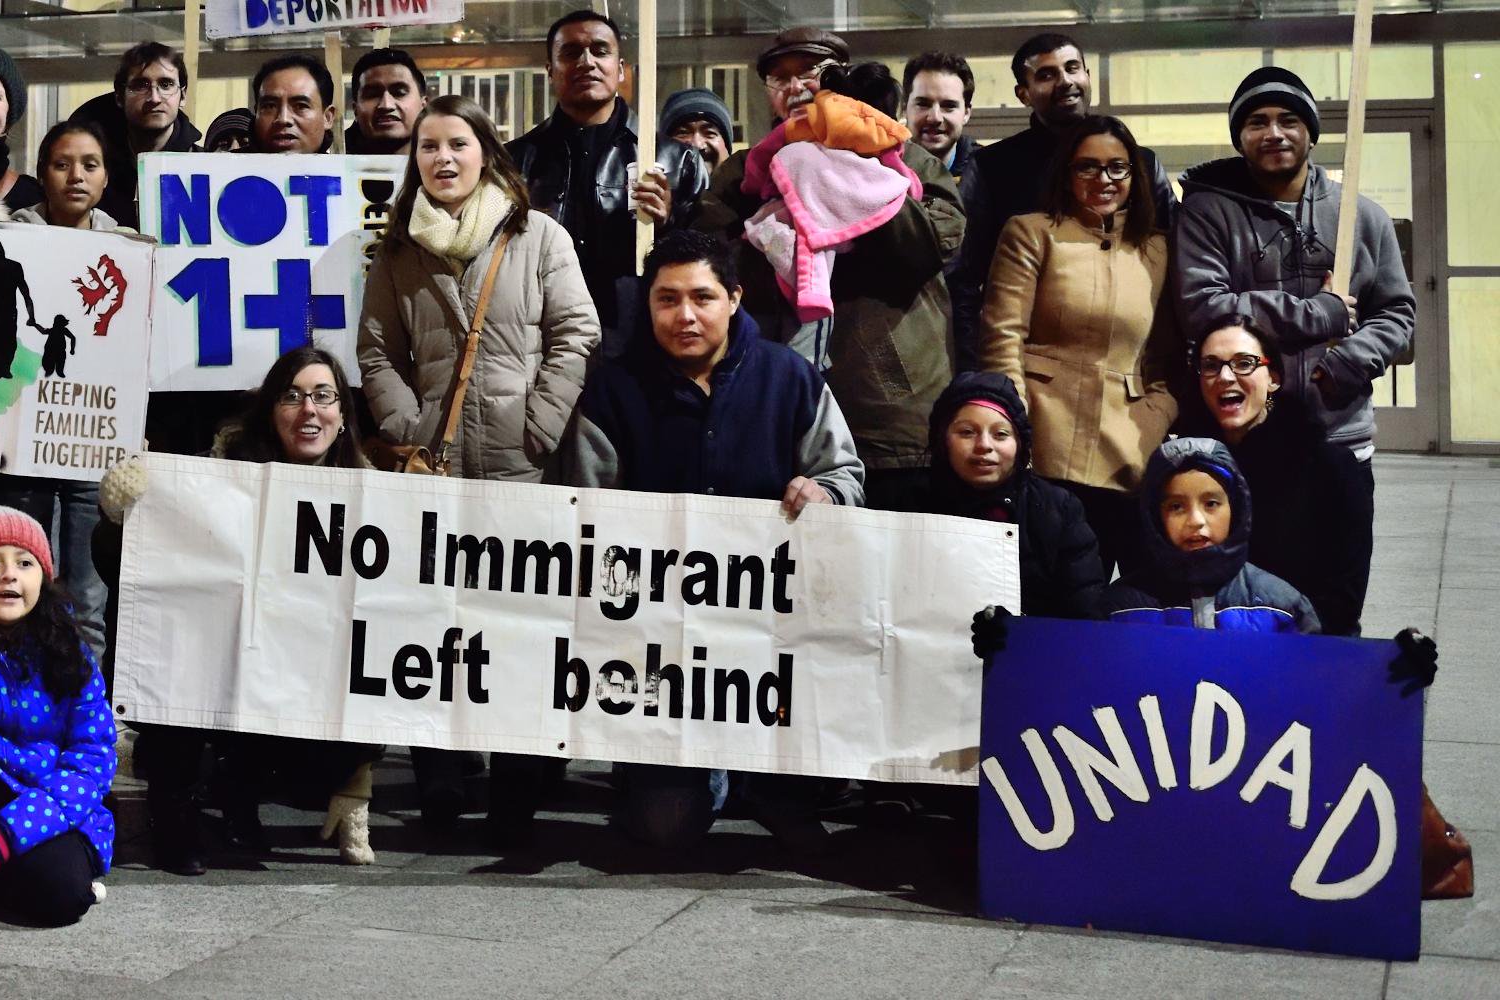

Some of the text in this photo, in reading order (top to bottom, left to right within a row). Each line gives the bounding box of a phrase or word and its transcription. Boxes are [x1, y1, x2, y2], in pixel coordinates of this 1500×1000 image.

[159, 174, 341, 247] NOT
[166, 258, 345, 366] 1+
[35, 410, 117, 440] FAMILIES
[37, 379, 117, 410] KEEPING
[293, 500, 797, 621] No Immigrant
[349, 619, 794, 728] Left behind
[982, 681, 1397, 900] UNIDAD
